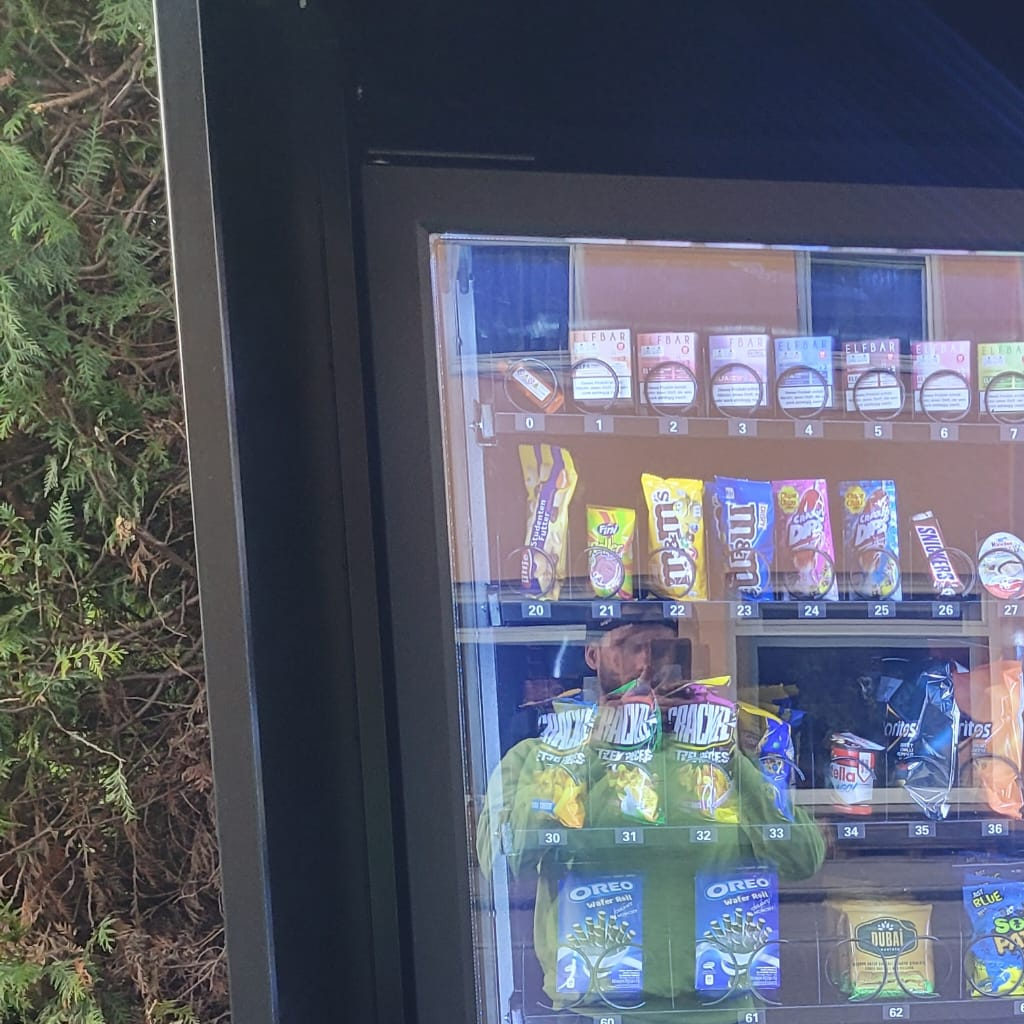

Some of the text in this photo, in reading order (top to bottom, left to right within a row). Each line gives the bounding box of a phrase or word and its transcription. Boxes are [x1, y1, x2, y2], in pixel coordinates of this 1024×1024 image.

[845, 344, 896, 354] ELFBAR
[526, 418, 534, 429] 0
[596, 420, 602, 430] 1
[669, 422, 678, 432] 2
[738, 422, 746, 434] 3
[805, 424, 813, 436] 4
[874, 426, 882, 436] 5
[940, 428, 948, 438] 6
[1010, 428, 1018, 439] 7
[531, 500, 546, 547] Studenten
[540, 512, 550, 541] Futter
[918, 526, 955, 582] SNICKERS
[528, 605, 544, 616] 20
[600, 605, 614, 616] 21
[670, 604, 685, 616] 22
[737, 605, 752, 616] 23
[804, 606, 820, 616] 24
[874, 605, 889, 616] 25
[938, 604, 954, 615] 26
[1004, 604, 1018, 616] 27
[884, 721, 918, 738] oritos
[958, 722, 992, 738] ritos
[831, 768, 856, 782] ella
[769, 828, 784, 838] 33
[844, 826, 858, 838] 34
[915, 825, 930, 836] 35
[988, 824, 1003, 834] 36
[545, 832, 560, 844] 30
[622, 832, 636, 842] 31
[696, 831, 712, 841] 32
[570, 881, 634, 901] OREO
[706, 878, 770, 898] OREO
[586, 894, 633, 909] Wafer Roll
[724, 891, 769, 906] Wafer Roll
[972, 891, 1003, 908] BLUE
[871, 928, 904, 947] DUBAI
[745, 1013, 759, 1023] 61
[889, 1008, 904, 1018] 62
